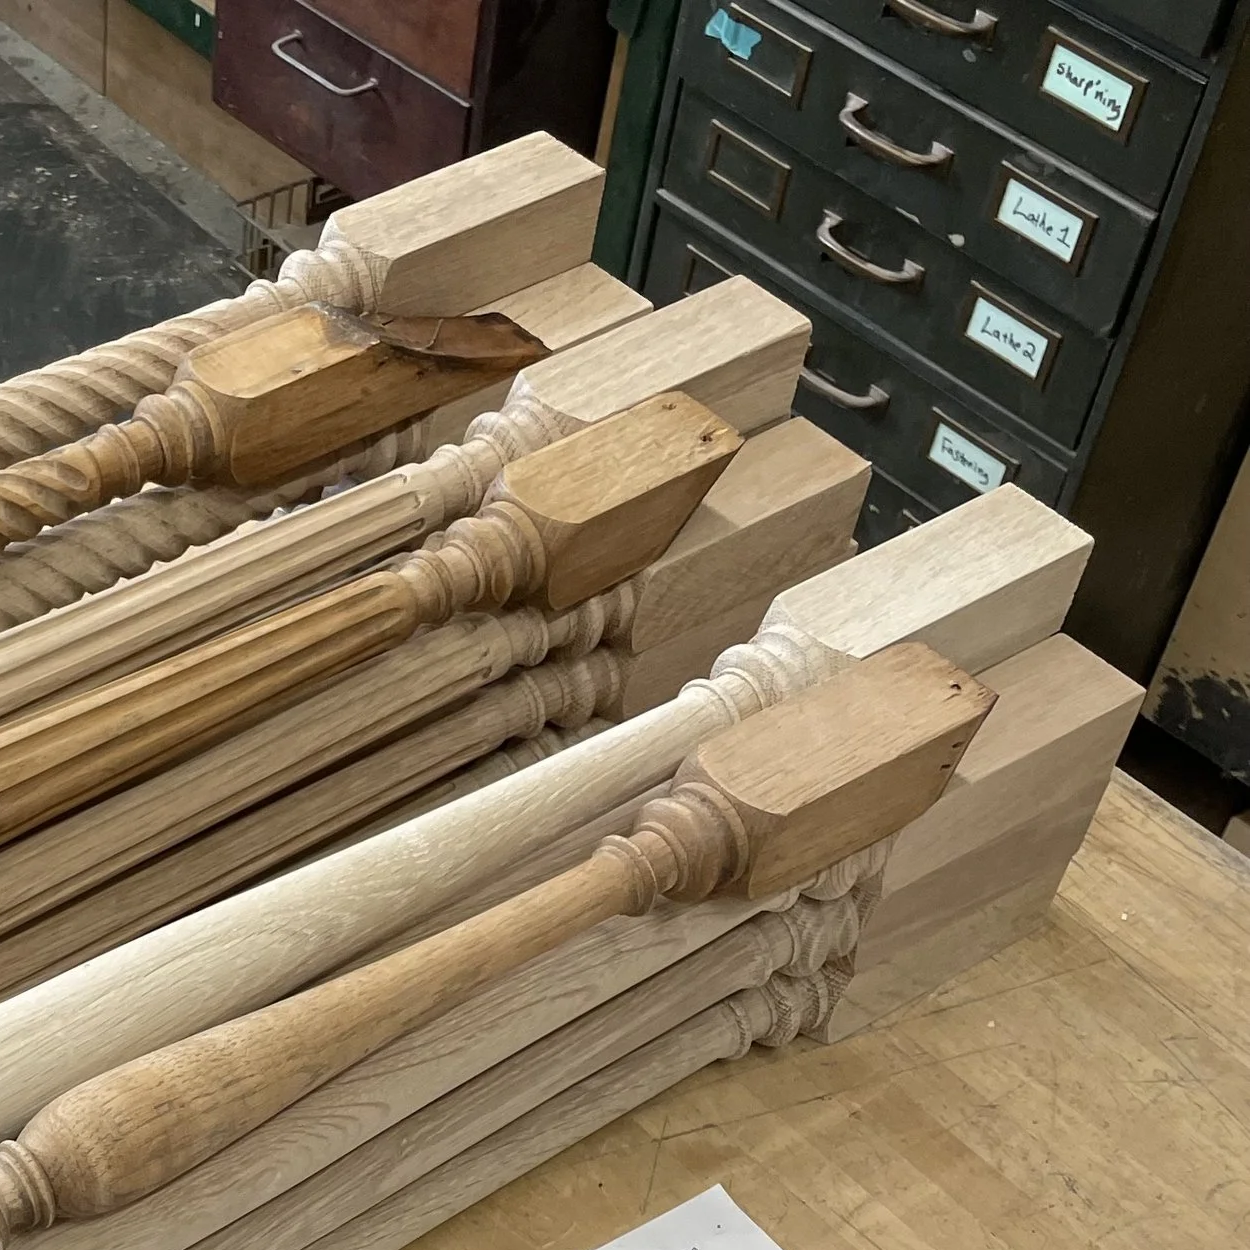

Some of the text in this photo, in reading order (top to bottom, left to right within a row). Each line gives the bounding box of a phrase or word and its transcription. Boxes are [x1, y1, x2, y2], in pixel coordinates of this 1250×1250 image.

[1012, 196, 1071, 248] Lathe 1
[981, 316, 1036, 363] Lathe 2
